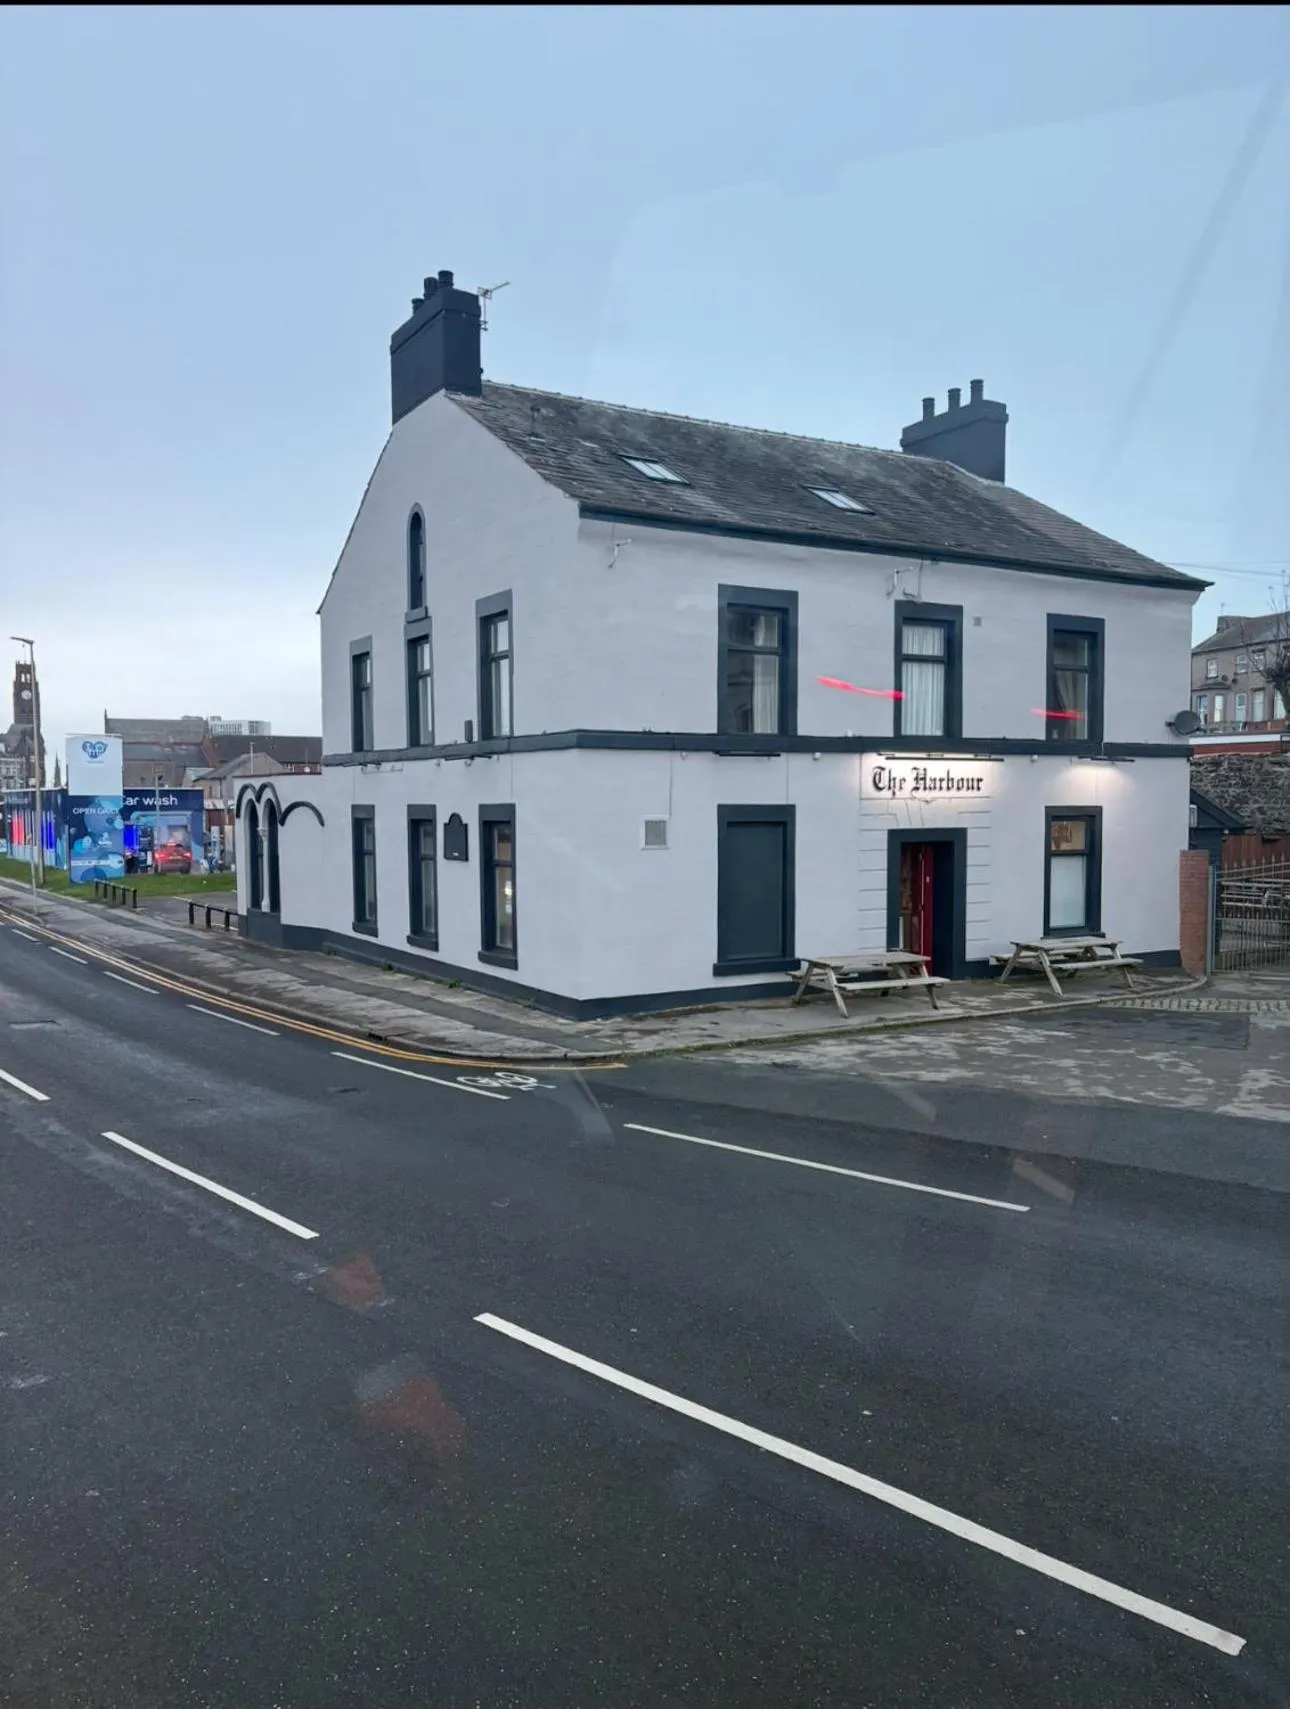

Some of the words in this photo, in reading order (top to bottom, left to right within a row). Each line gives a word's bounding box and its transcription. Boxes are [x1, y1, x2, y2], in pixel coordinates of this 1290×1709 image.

[872, 765, 906, 799] The
[911, 766, 984, 793] Harbour
[142, 794, 178, 806] wash
[72, 807, 96, 815] OPEN
